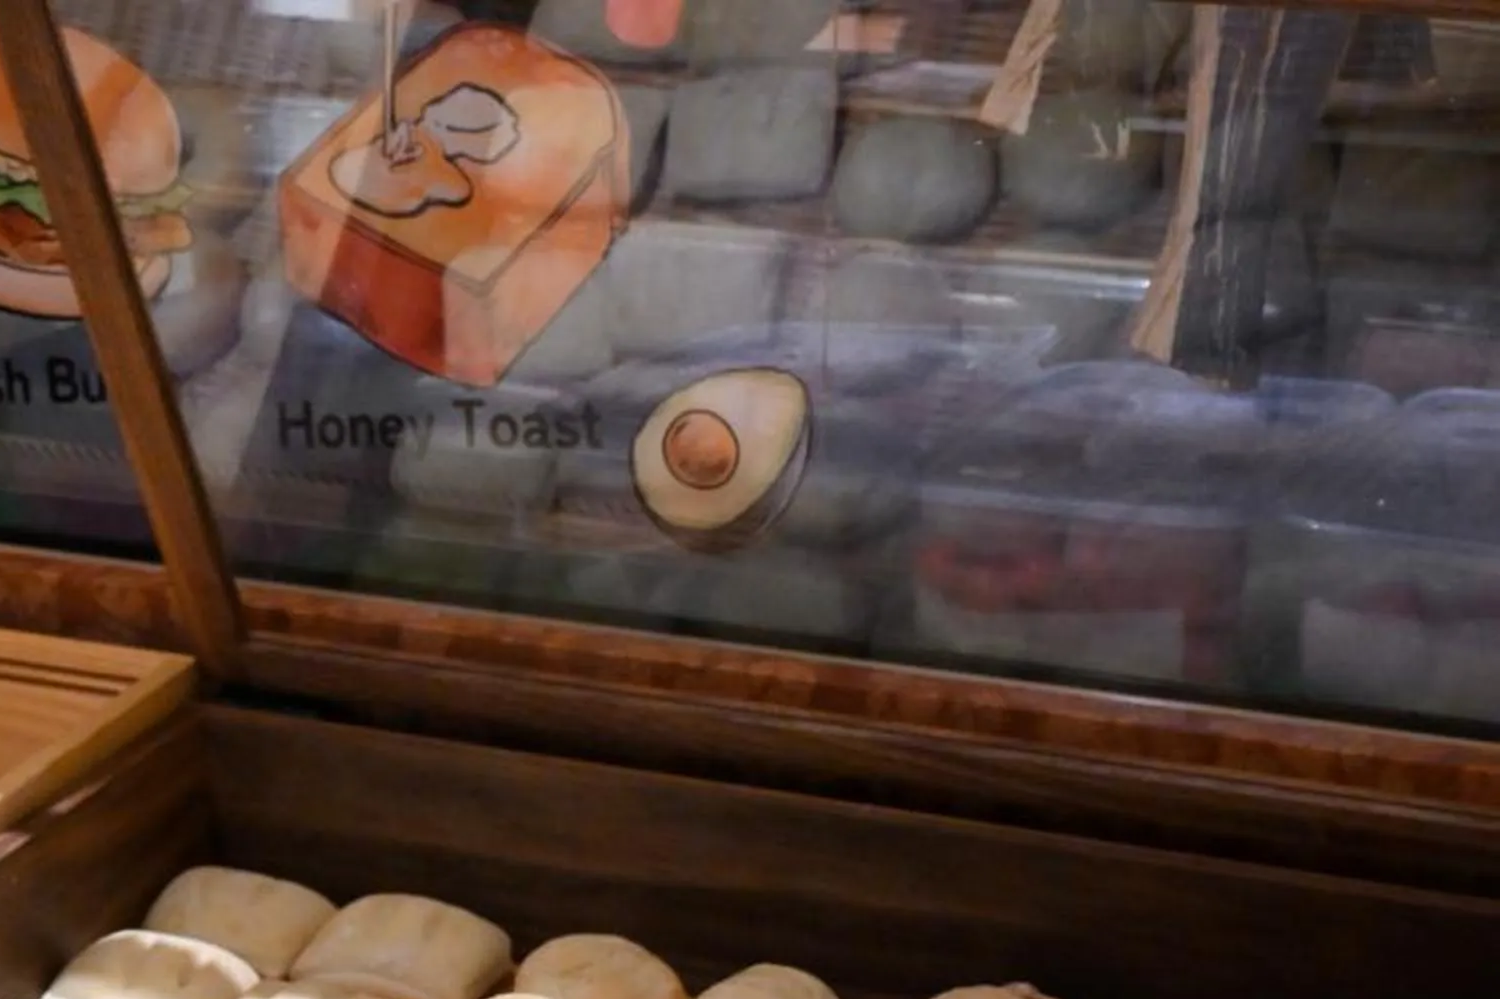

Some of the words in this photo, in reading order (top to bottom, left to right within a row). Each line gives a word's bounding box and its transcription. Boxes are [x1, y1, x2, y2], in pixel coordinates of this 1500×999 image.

[46, 357, 108, 403] Bu
[277, 401, 435, 461] Honey
[452, 399, 603, 450] Toast
